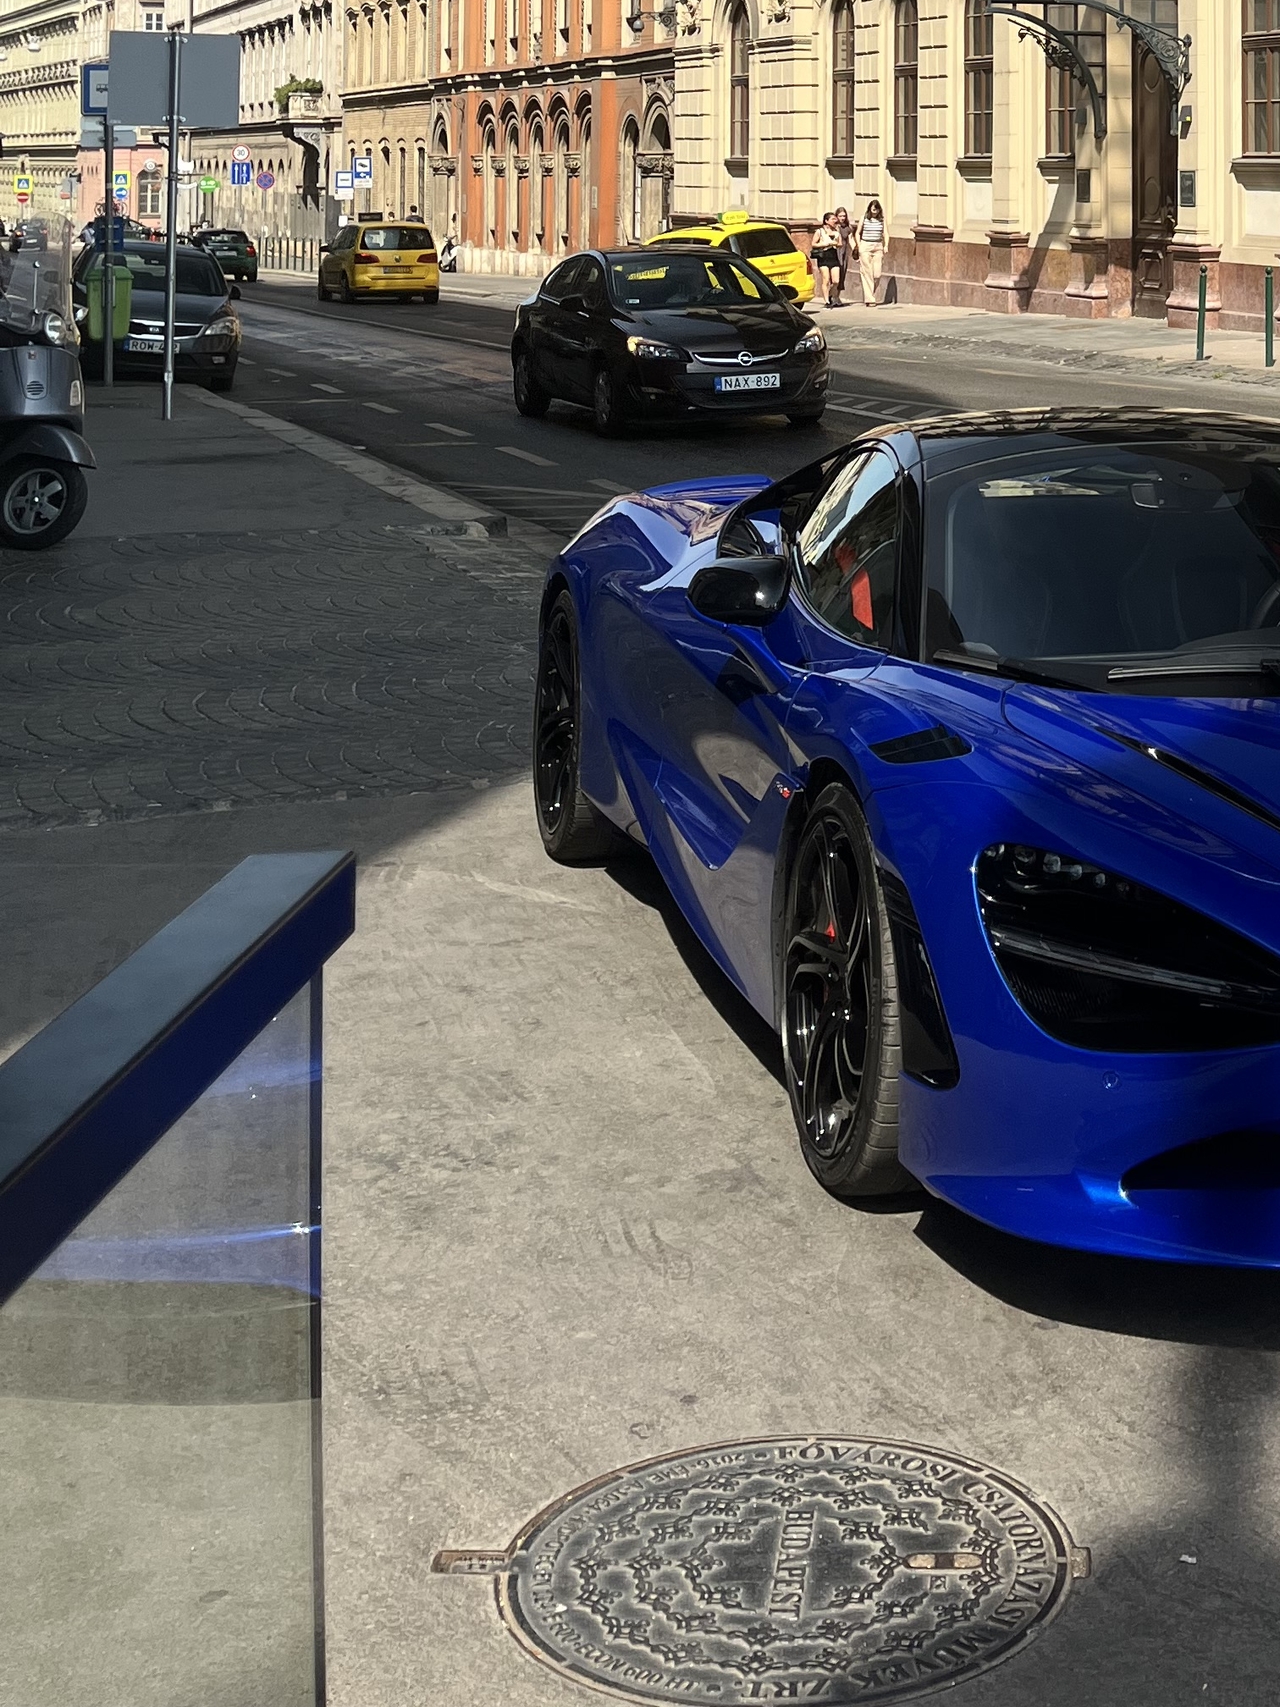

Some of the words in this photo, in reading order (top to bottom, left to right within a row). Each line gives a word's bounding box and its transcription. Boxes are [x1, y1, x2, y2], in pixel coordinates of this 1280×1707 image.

[236, 149, 246, 157] 30
[131, 340, 178, 354] ROW-42
[724, 375, 777, 390] NAX-892
[777, 1441, 960, 1484] FŐVÁROSI
[961, 1481, 1056, 1631] CSATORNÁZÁSI
[767, 1509, 815, 1621] BUDAPEST
